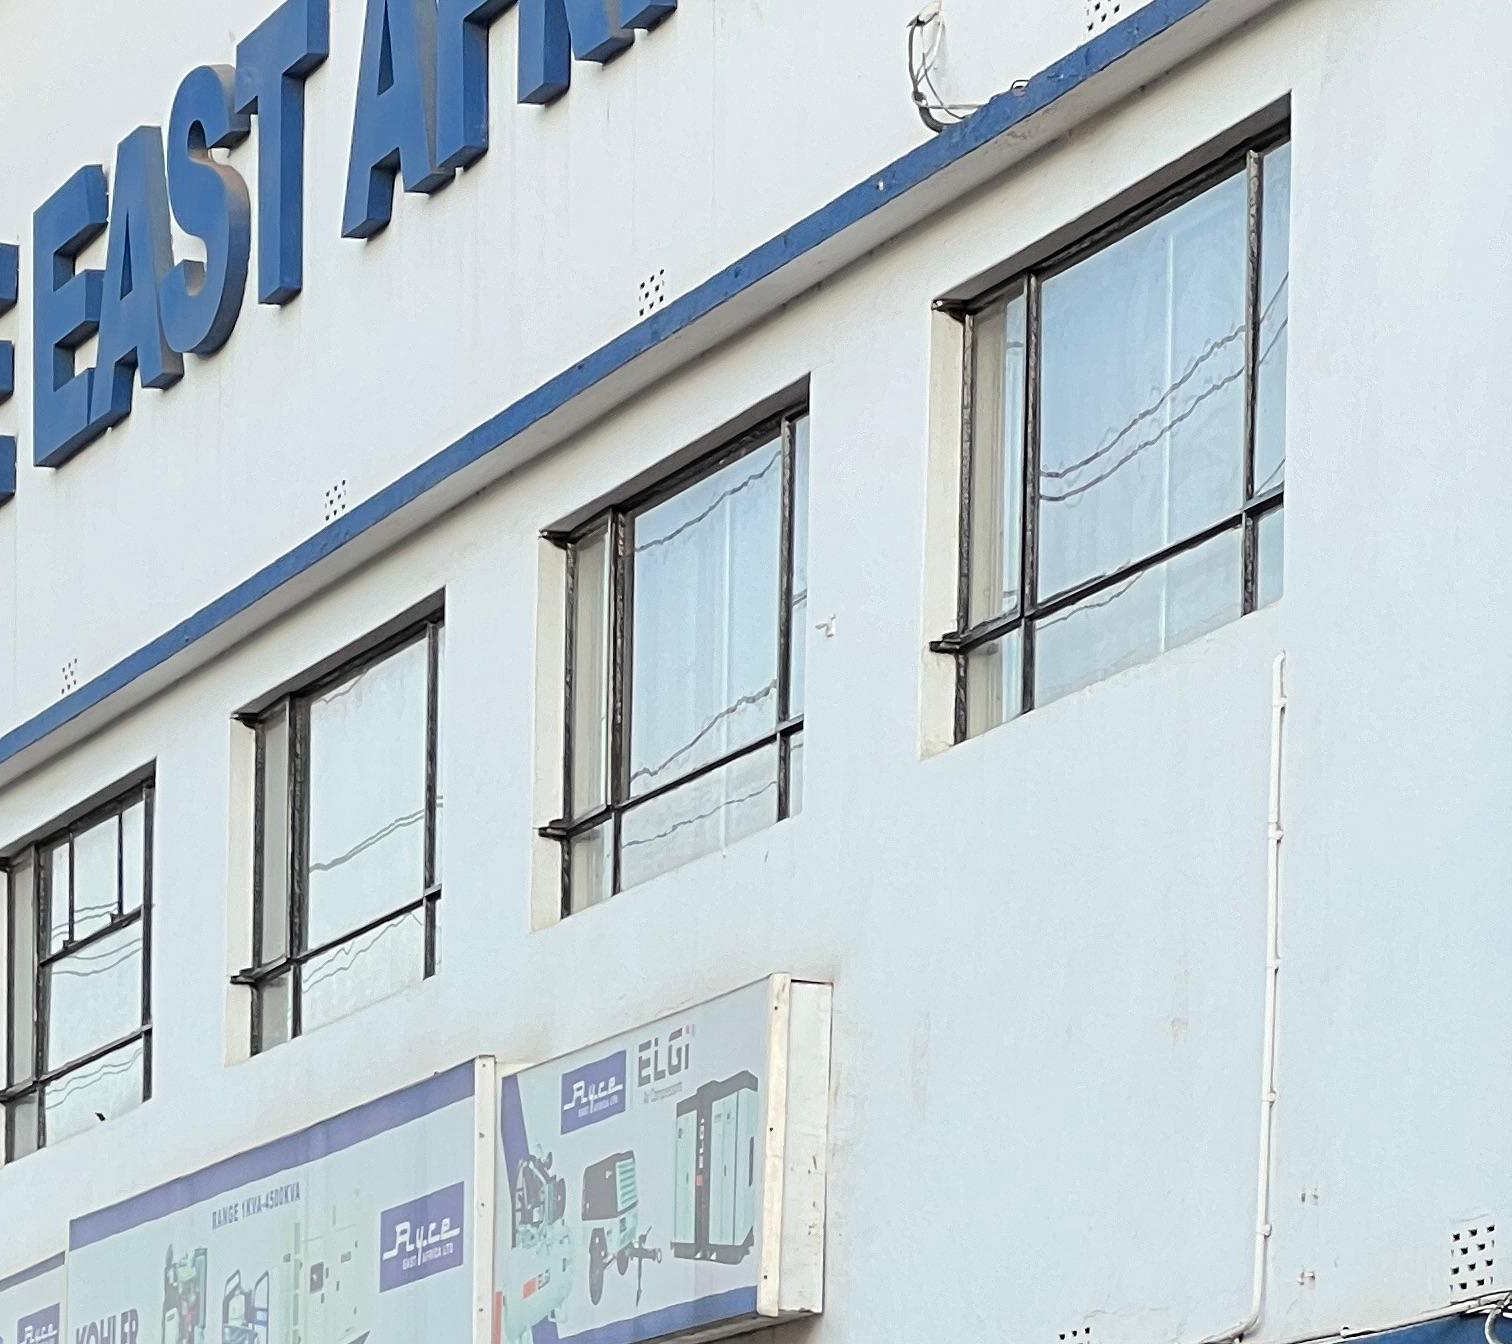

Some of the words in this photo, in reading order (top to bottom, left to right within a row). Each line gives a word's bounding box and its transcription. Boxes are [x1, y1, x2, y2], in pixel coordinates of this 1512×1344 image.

[34, 0, 330, 468] EAST
[342, 0, 678, 240] AF
[212, 1203, 239, 1231] RANGE
